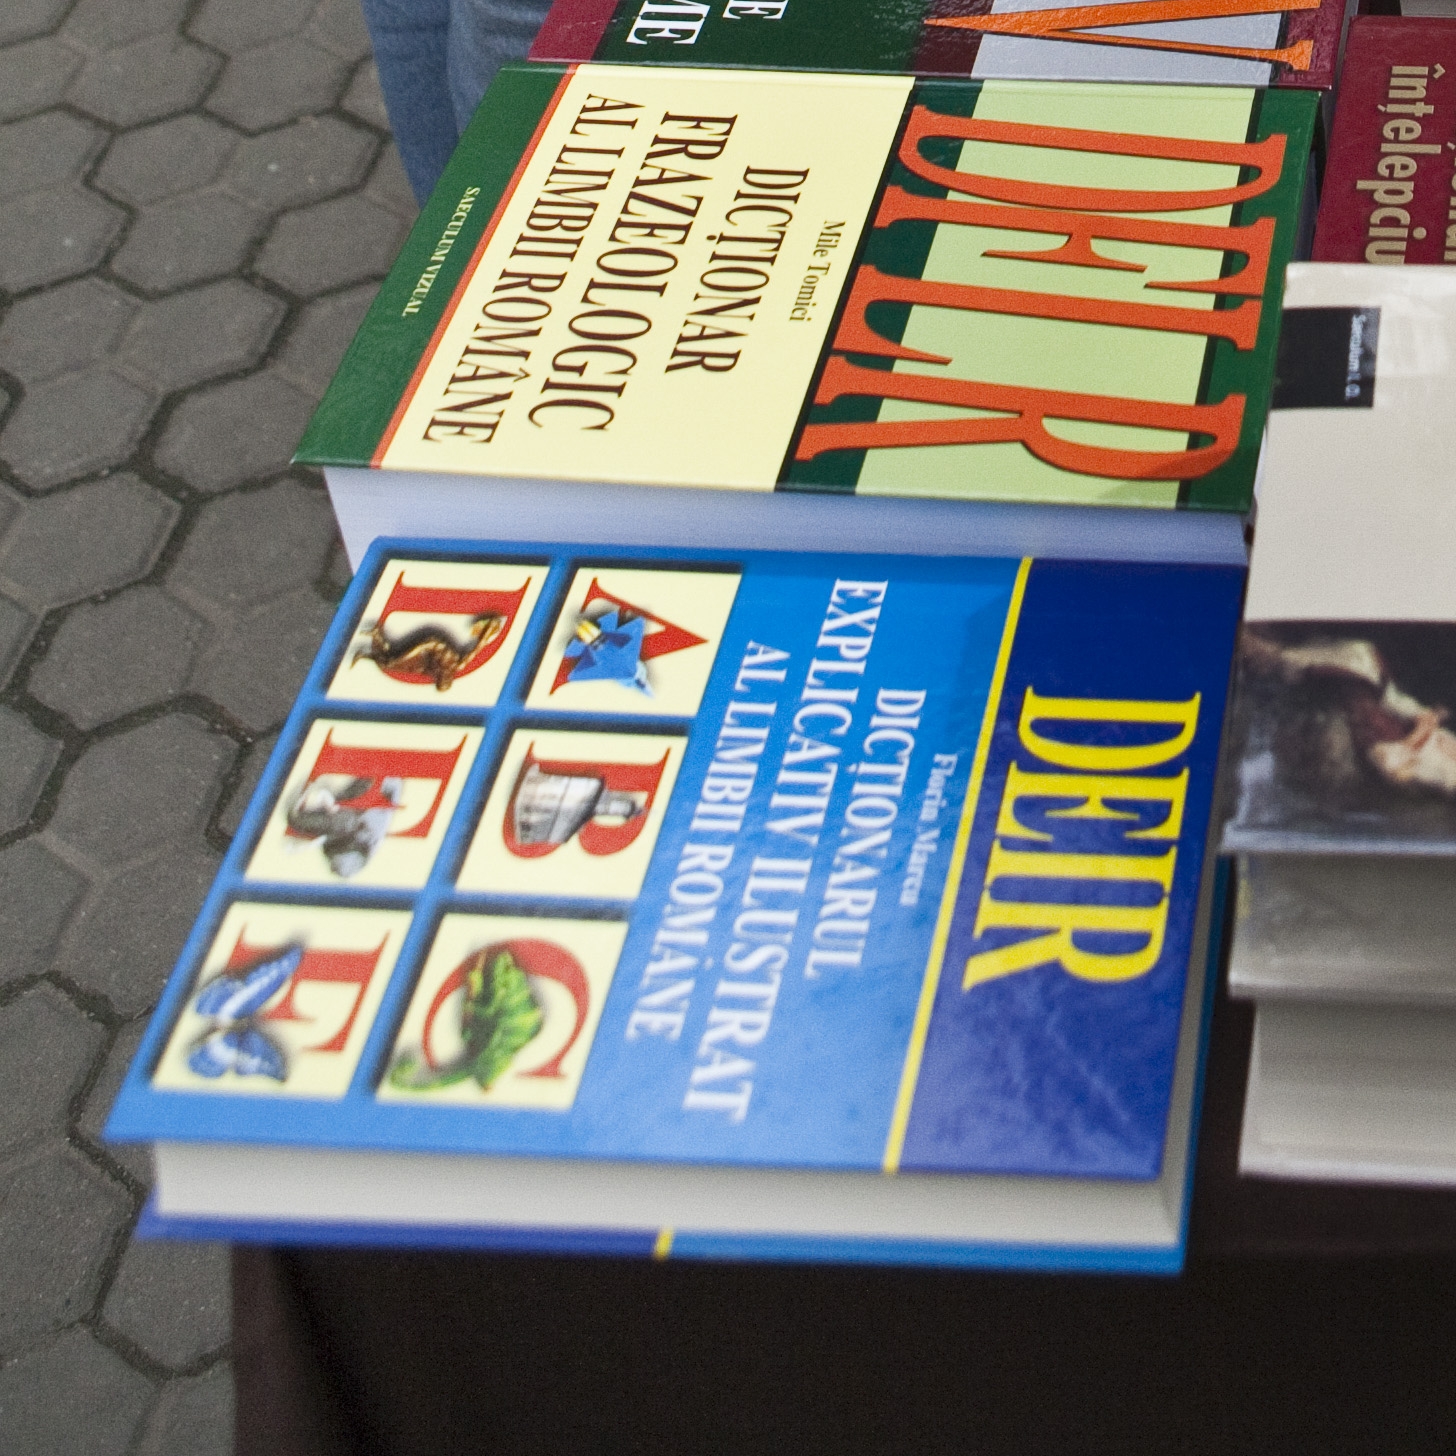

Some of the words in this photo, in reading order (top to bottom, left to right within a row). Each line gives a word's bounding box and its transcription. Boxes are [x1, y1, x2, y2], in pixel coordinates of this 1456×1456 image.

[569, 93, 646, 136] AL
[1355, 63, 1446, 265] înțelepciu
[426, 185, 481, 264] SAECULUM
[508, 144, 626, 263] LIMBII
[527, 110, 739, 432] FRAZEOLOGIC
[664, 164, 811, 375] DICȚIONAR
[811, 219, 847, 259] Mile
[401, 259, 443, 318] VIZUAL
[421, 268, 568, 444] ROMÂNE
[788, 260, 832, 323] Tomici
[795, 104, 1288, 482] DFLR
[734, 640, 793, 691] AL
[768, 576, 889, 848] EXPLICATIV
[502, 740, 671, 861] B
[686, 698, 777, 839] LIMBII
[804, 687, 927, 981] DICȚIONARUL
[924, 751, 960, 823] Florin
[962, 685, 1202, 994] DER
[901, 825, 943, 909] Marcu
[423, 937, 591, 1080] C
[624, 841, 737, 1043] ROMÂNE
[682, 854, 814, 1123] ILUSTRAT
